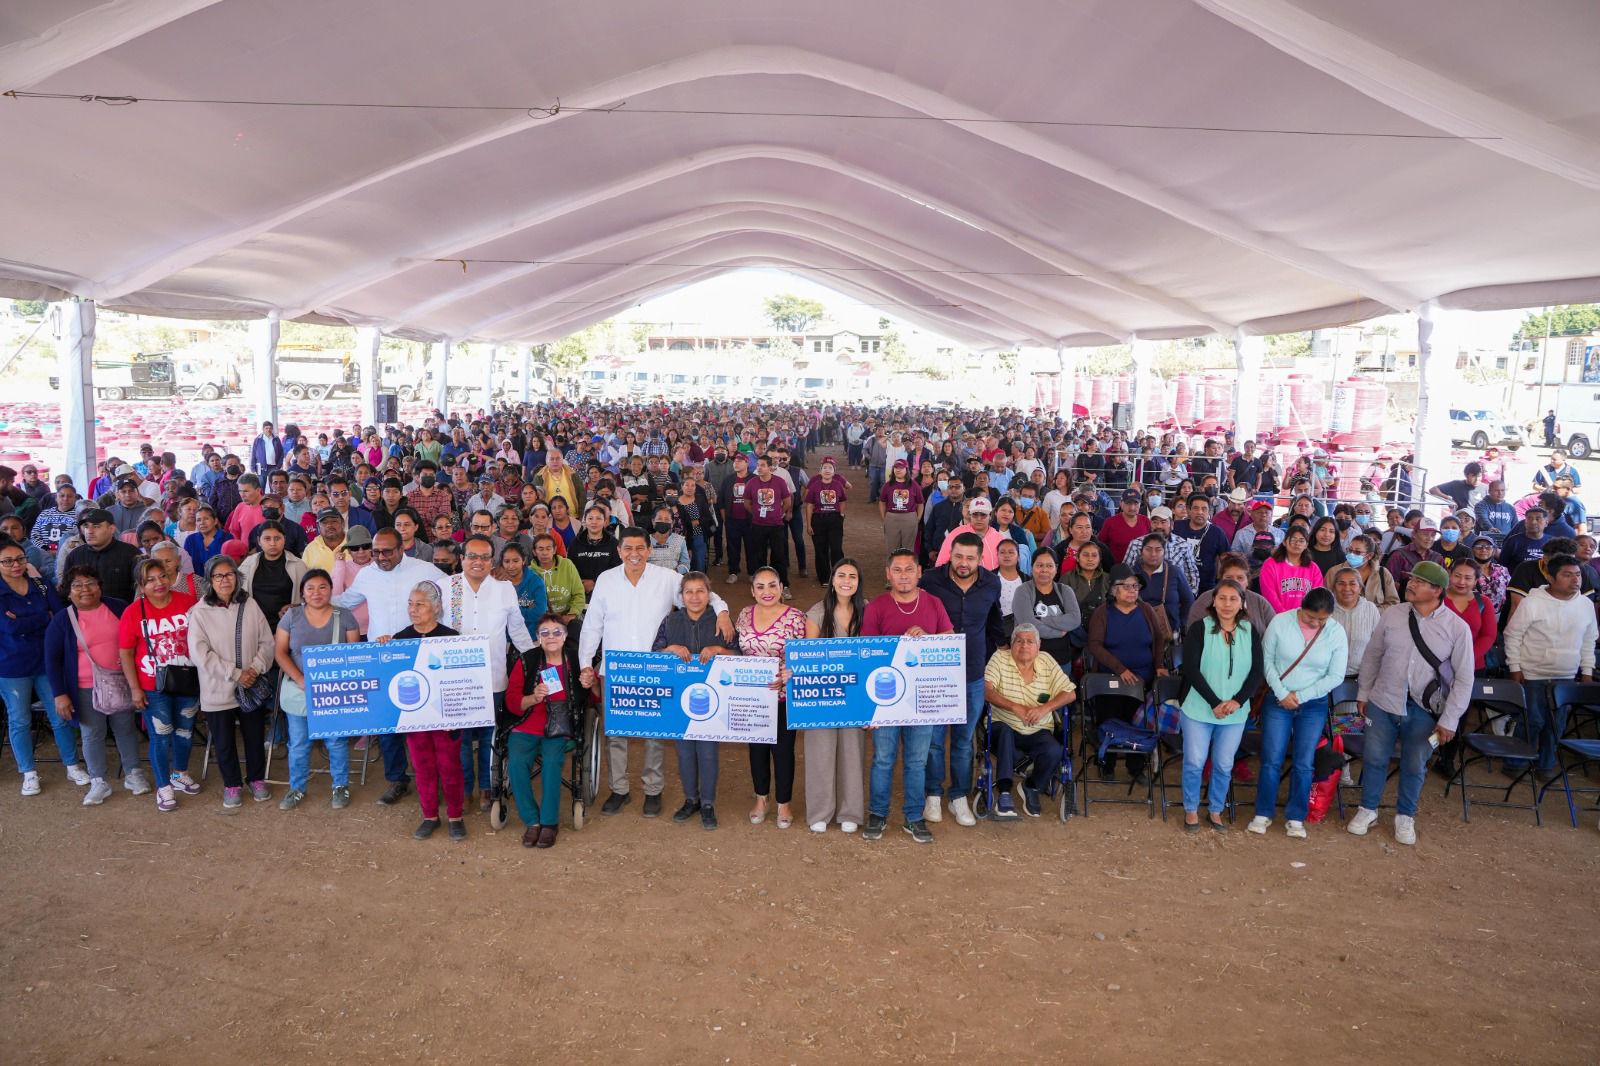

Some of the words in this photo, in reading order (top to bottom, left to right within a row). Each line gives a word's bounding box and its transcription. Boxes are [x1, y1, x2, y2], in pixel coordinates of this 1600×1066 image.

[443, 654, 485, 664] TODOS
[920, 653, 961, 662] TODOS
[791, 664, 819, 673] VALE
[821, 663, 844, 672] POR
[309, 670, 339, 680] VALE
[341, 669, 365, 678] POR
[610, 674, 636, 683] VALE
[638, 676, 661, 684] POR
[735, 674, 773, 683] TODOS
[792, 675, 837, 686] TINACO
[840, 674, 856, 684] DE
[312, 681, 358, 693] TINACO
[361, 679, 378, 690] DE
[611, 685, 653, 696] TINACO
[656, 687, 672, 697] DE
[792, 689, 819, 699] 1,100
[822, 687, 845, 697] LTS.
[312, 696, 340, 708] 1,100
[343, 694, 368, 705] LTS.
[611, 698, 636, 708] 1,100
[639, 699, 661, 709] LTS.
